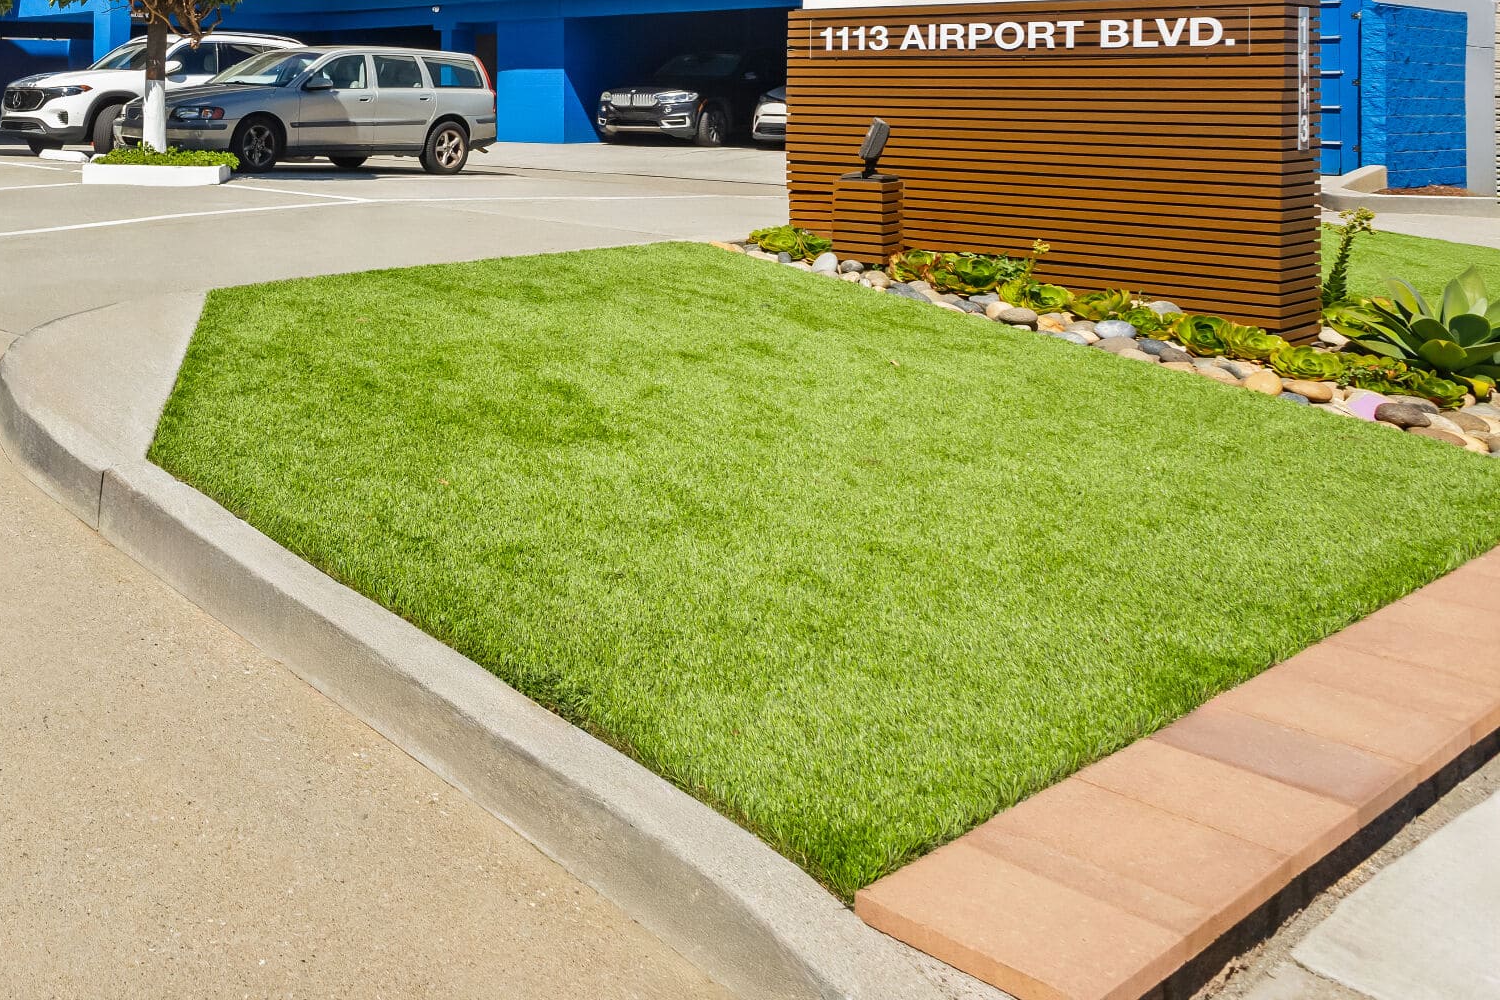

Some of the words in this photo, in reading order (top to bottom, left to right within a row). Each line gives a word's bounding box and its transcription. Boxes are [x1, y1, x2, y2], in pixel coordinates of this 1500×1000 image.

[819, 25, 889, 51] 1113
[899, 20, 1085, 50] AIRPORT
[1100, 17, 1236, 48] BLVD.
